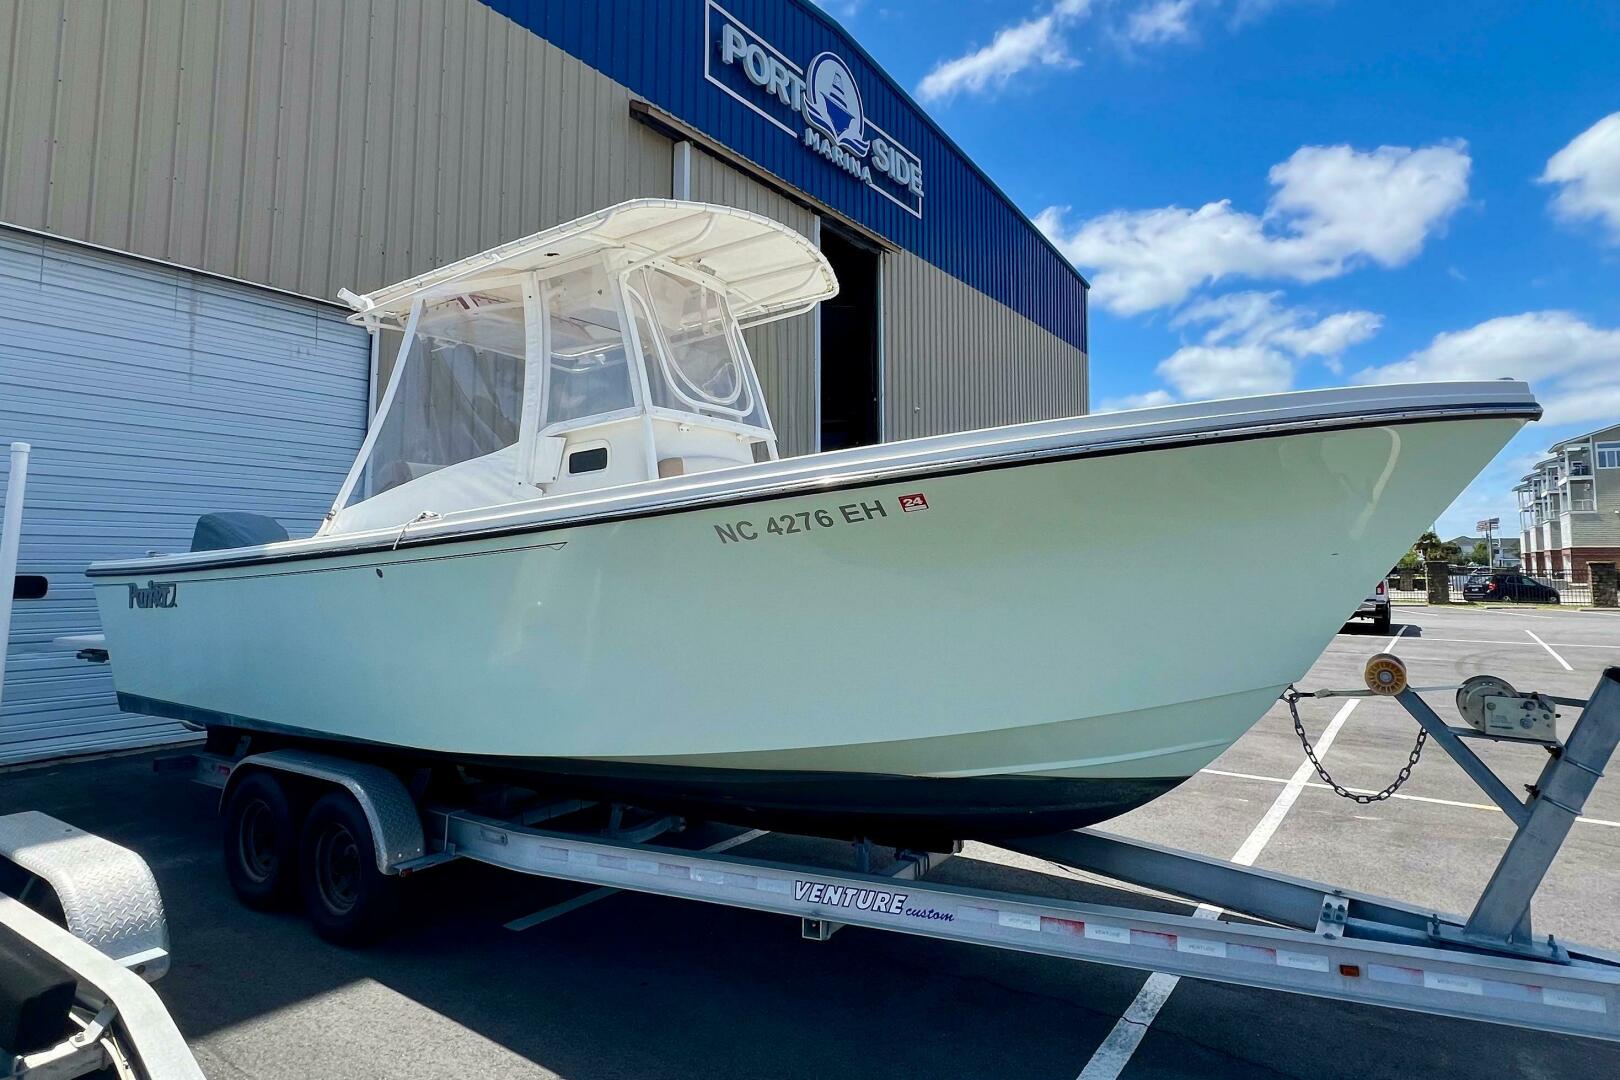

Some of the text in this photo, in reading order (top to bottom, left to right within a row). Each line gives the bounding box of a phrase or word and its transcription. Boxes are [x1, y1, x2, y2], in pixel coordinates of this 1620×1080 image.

[722, 23, 806, 112] PORT
[804, 127, 873, 184] MARINA
[871, 137, 924, 197] SIDE
[714, 500, 888, 544] NC 4276 EH
[903, 496, 923, 507] 24
[794, 880, 955, 922] VENTURE custom
